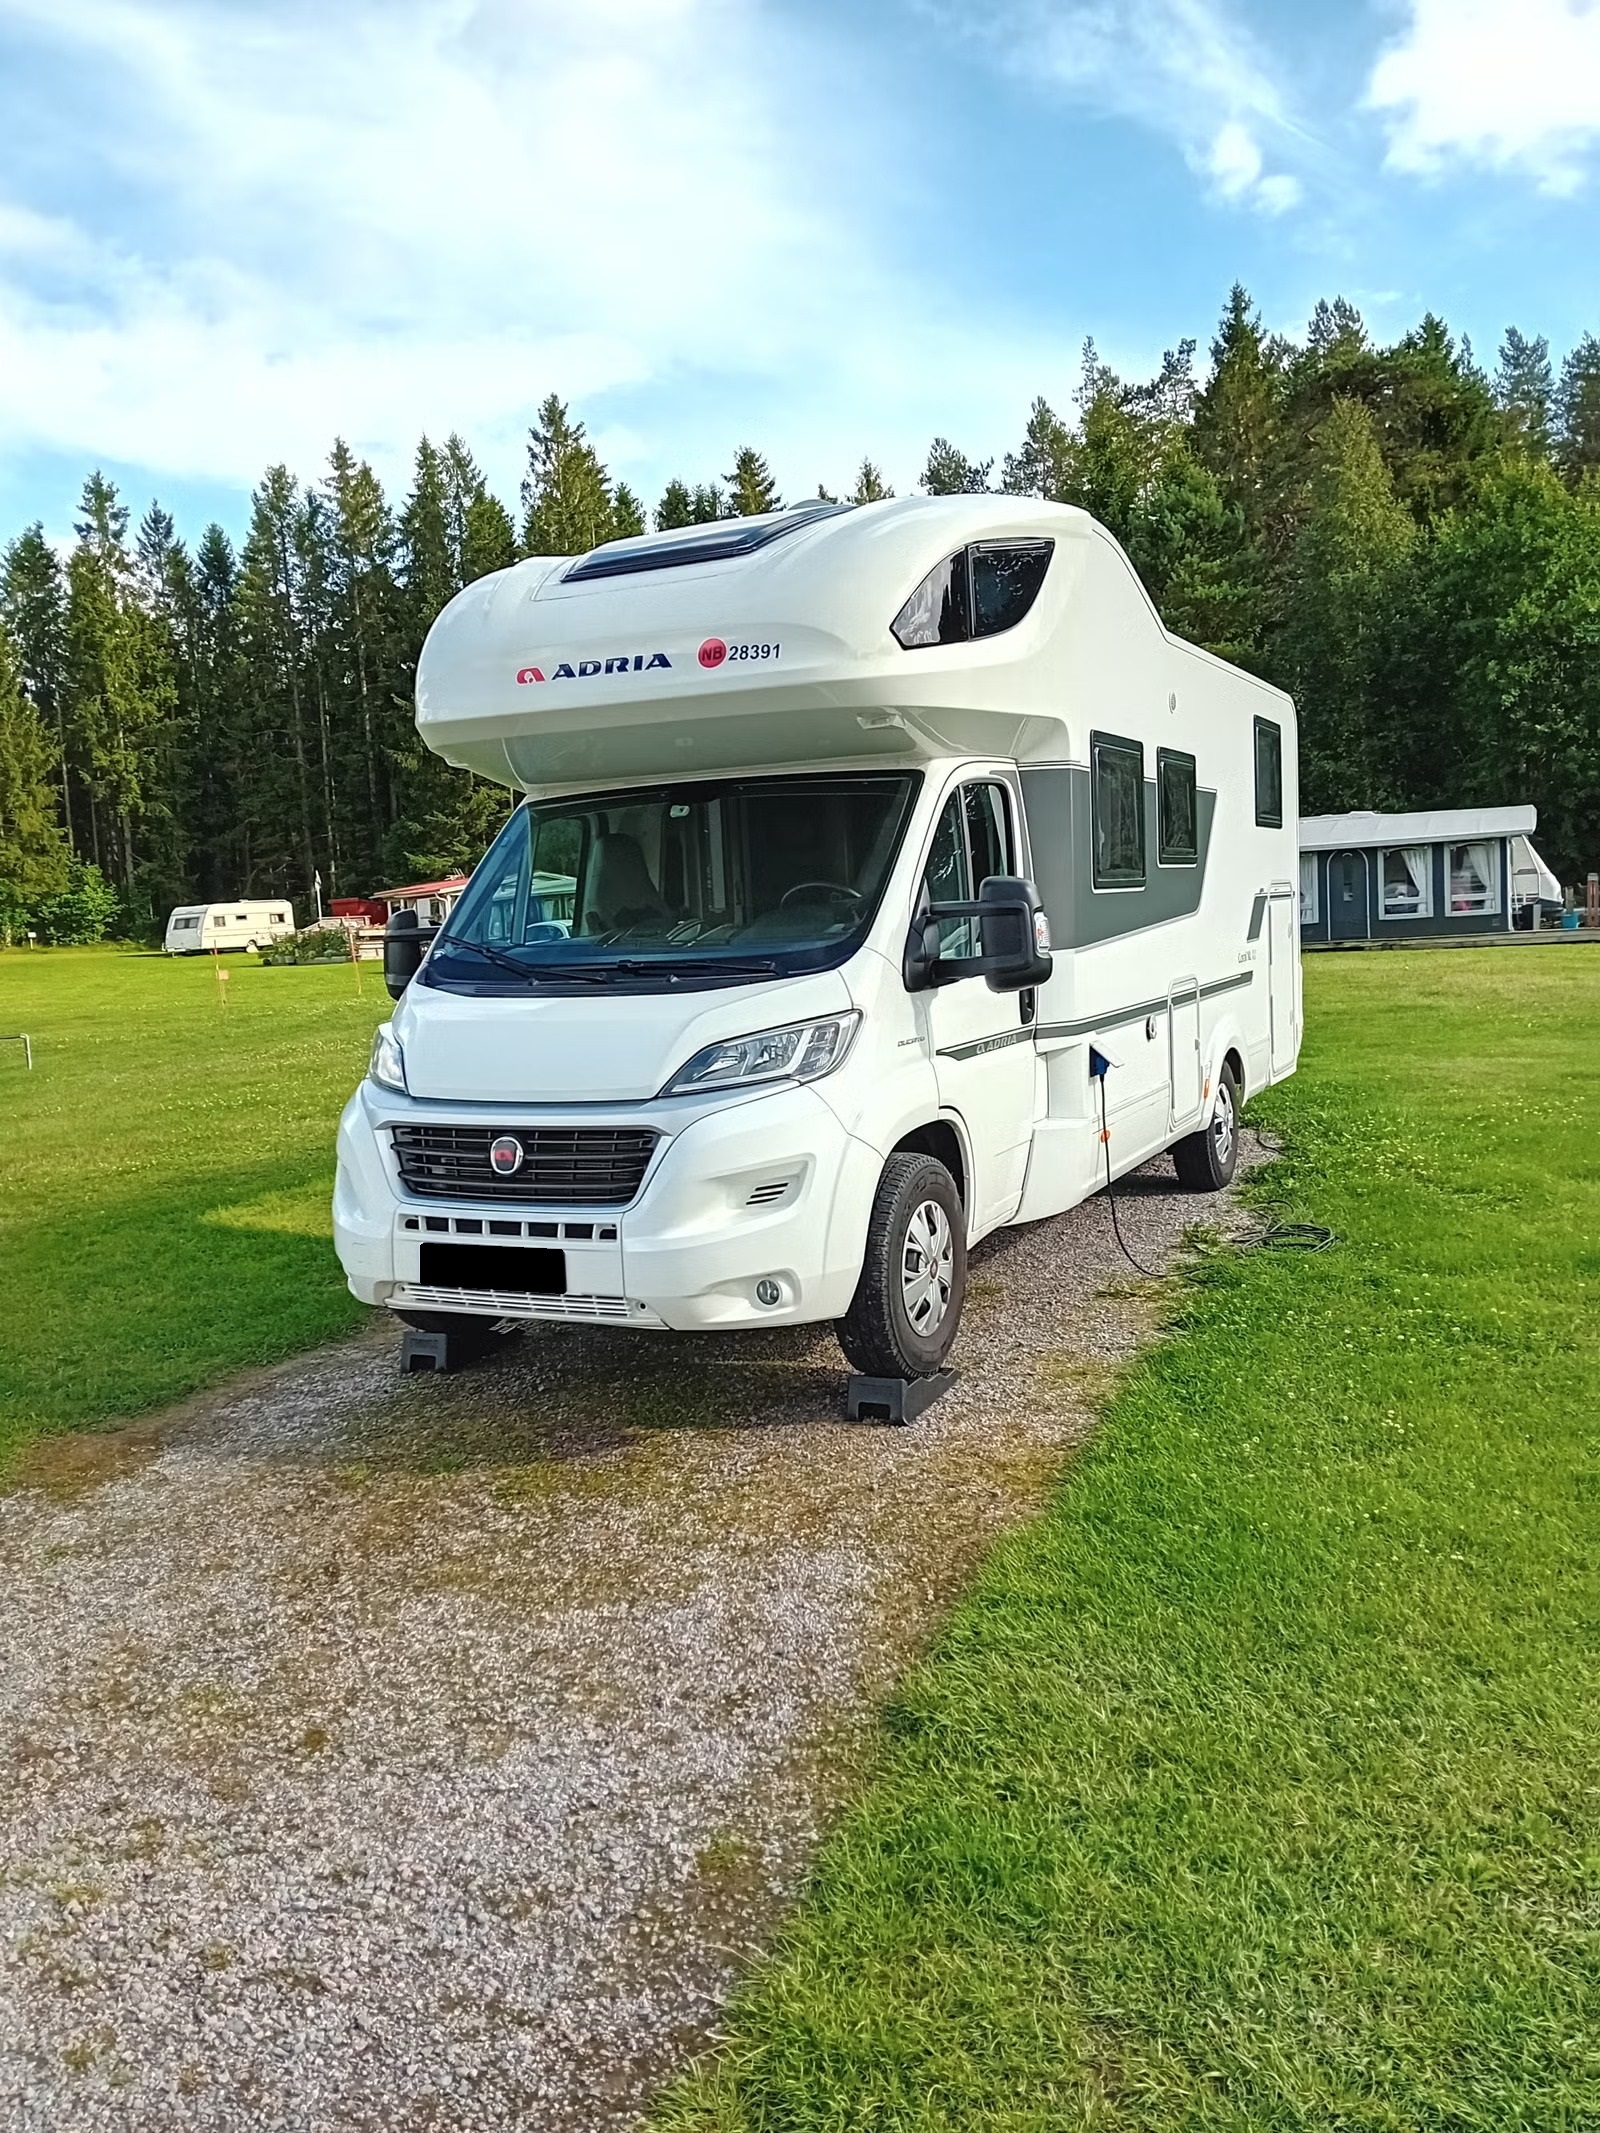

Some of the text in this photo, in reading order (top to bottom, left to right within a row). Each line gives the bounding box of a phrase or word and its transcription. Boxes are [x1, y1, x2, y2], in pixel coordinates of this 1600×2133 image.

[701, 643, 781, 662] NB 28391
[551, 653, 672, 681] ADRIA
[986, 1034, 1017, 1051] ADRIA
